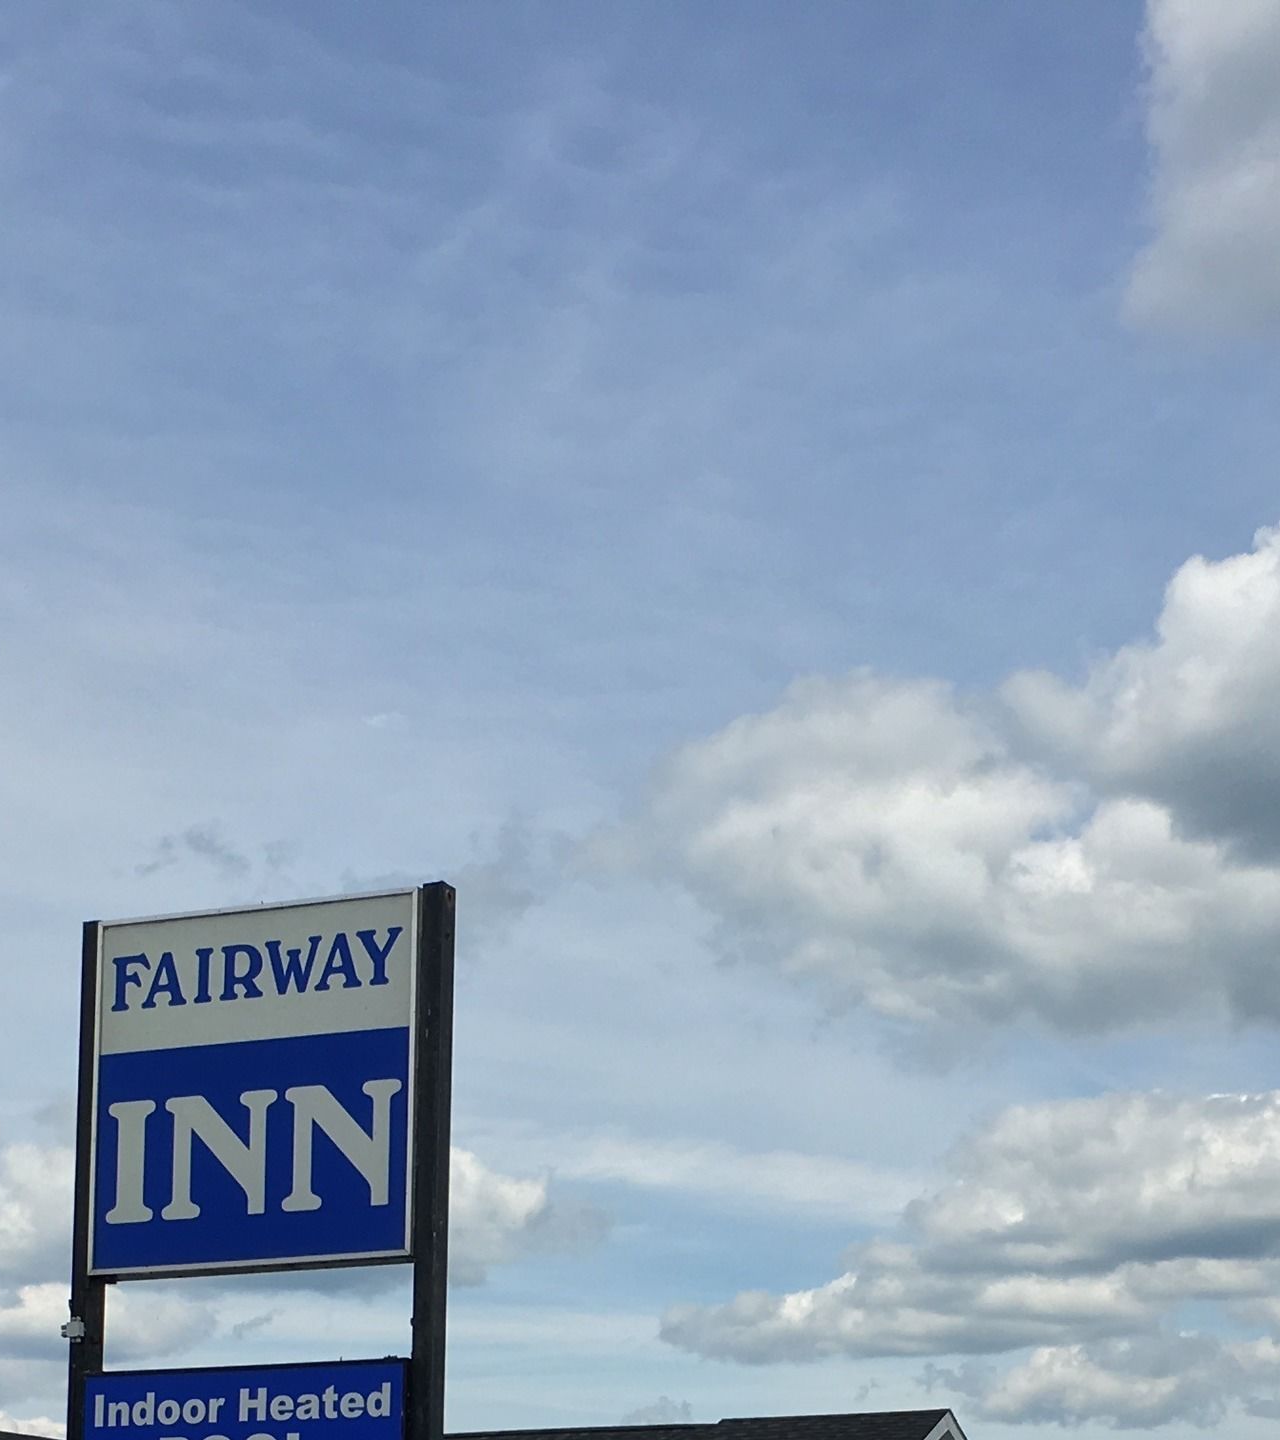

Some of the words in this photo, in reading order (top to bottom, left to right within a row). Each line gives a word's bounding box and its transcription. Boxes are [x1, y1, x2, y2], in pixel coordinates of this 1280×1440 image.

[111, 926, 403, 1012] FAIRWAY
[105, 1078, 402, 1225] INN
[94, 1392, 225, 1428] Indoor
[238, 1382, 392, 1422] Heated
